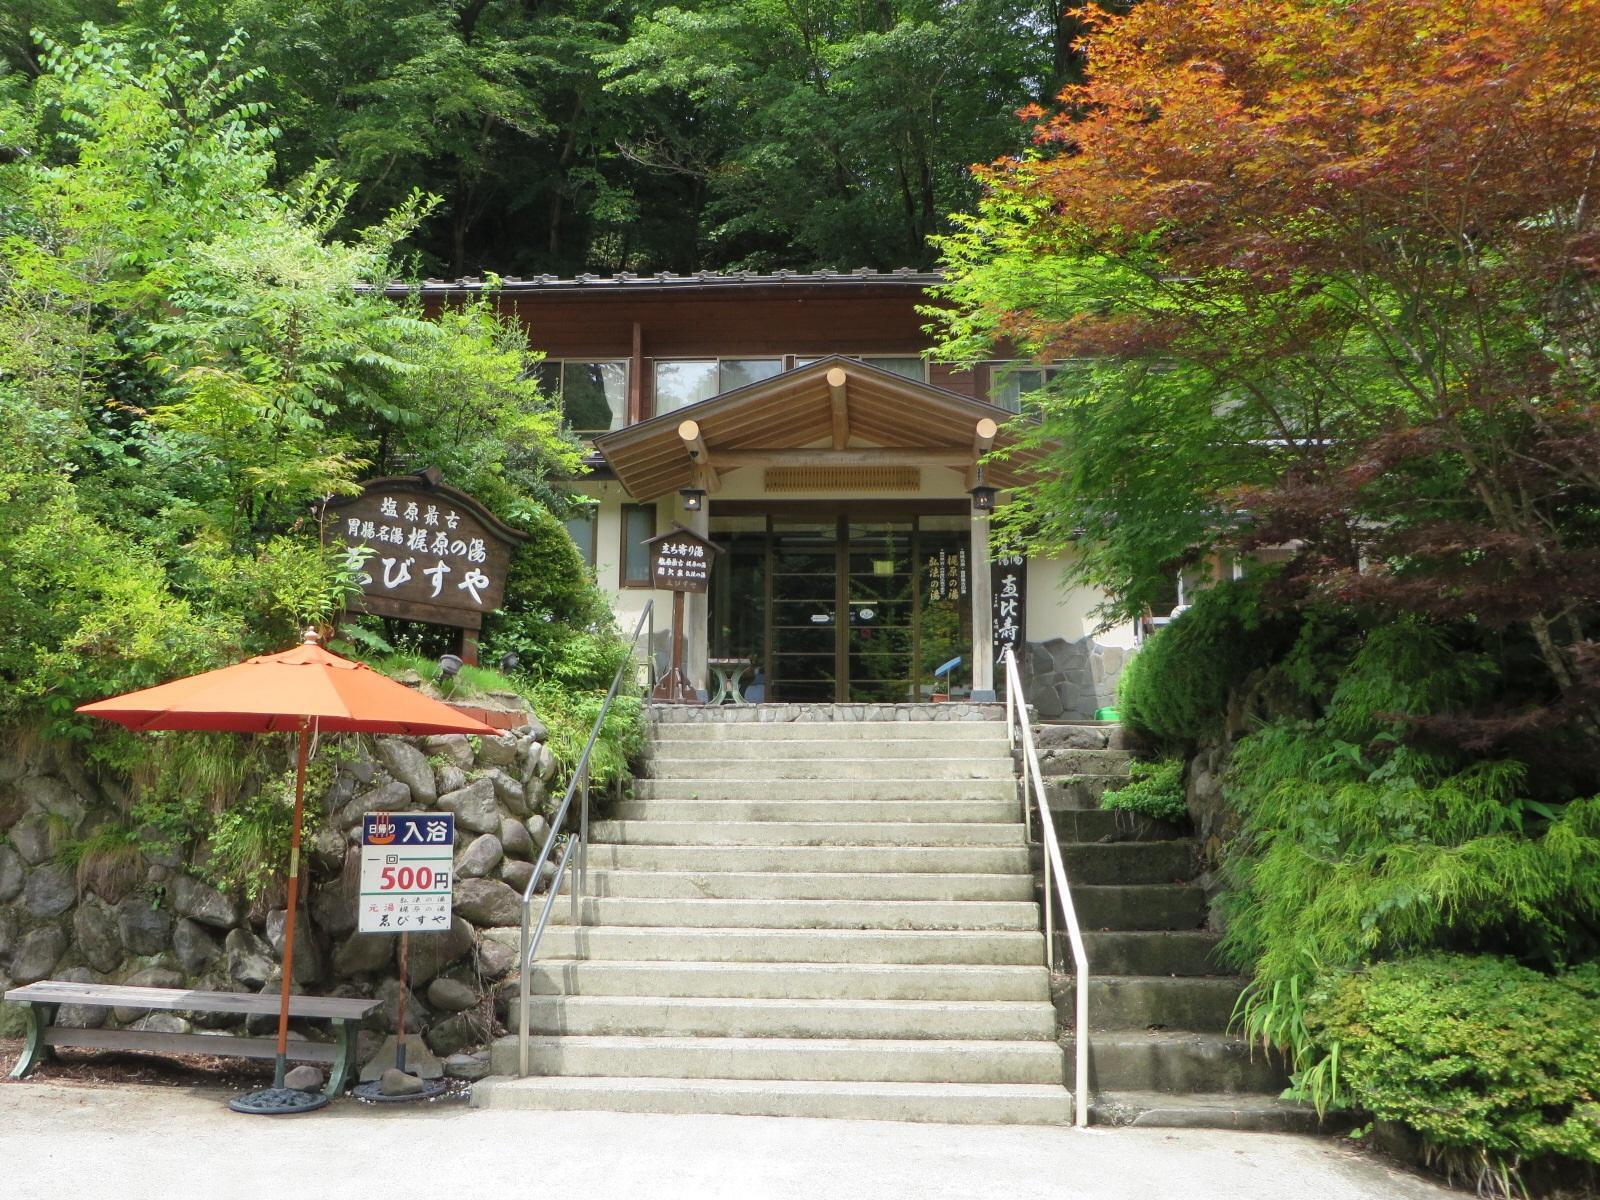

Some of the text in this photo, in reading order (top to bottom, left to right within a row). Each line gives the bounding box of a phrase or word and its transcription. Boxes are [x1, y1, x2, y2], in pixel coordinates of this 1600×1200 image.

[380, 496, 461, 530] 塩原最古
[347, 518, 487, 564] 胃腸名湯 梶原の湯
[661, 542, 704, 557] 立ち寄り湯
[368, 821, 448, 843] 日帰り 入浴
[367, 854, 399, 865] 一回
[379, 866, 449, 890] 500円
[368, 903, 395, 913] 元湯
